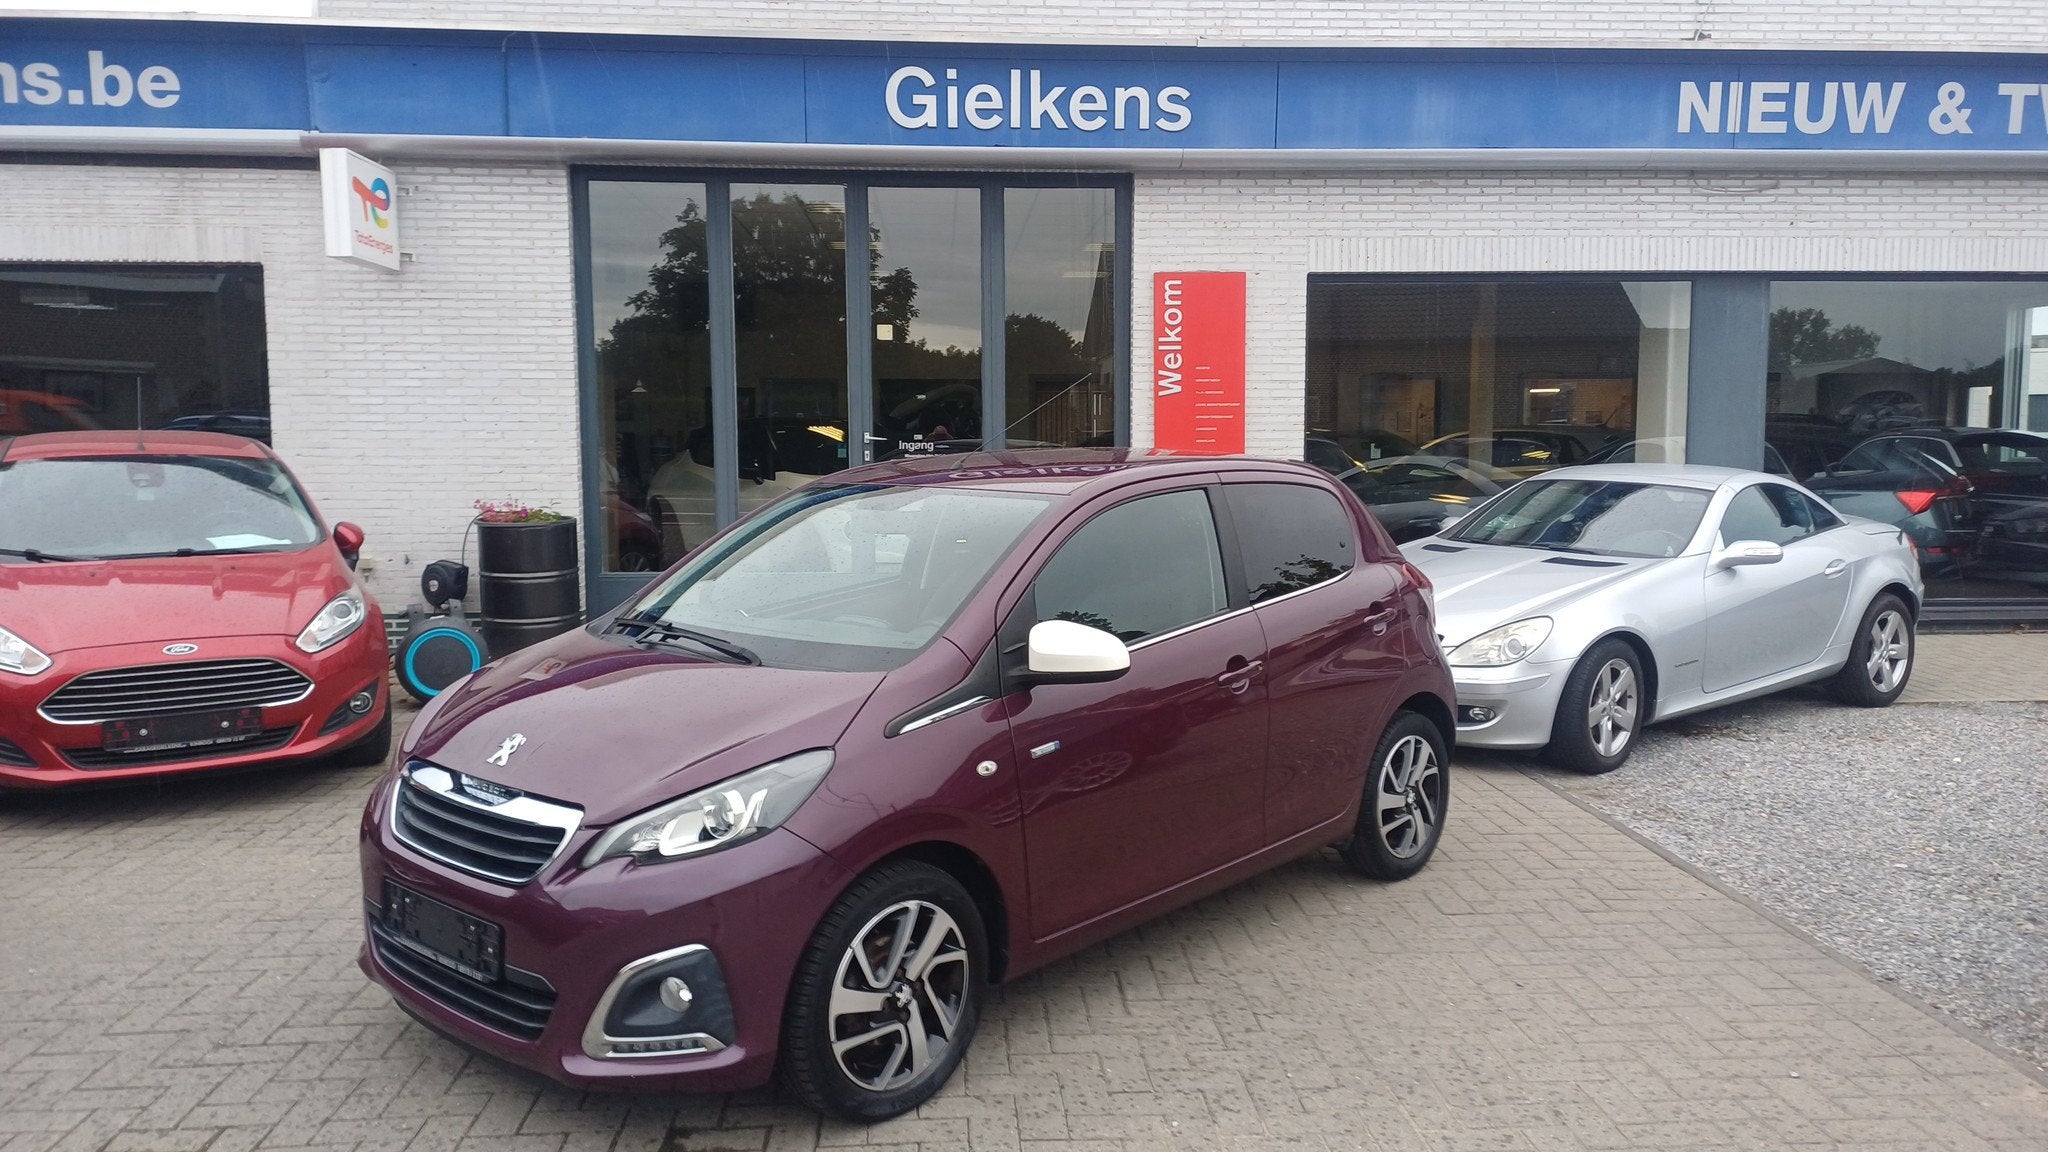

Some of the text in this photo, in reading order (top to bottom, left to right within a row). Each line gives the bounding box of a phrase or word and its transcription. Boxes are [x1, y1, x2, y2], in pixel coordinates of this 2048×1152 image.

[885, 65, 1192, 132] Gielkens
[1677, 81, 2048, 135] NIEUW & T
[1158, 279, 1183, 397] Welkom
[898, 439, 934, 452] Ingang
